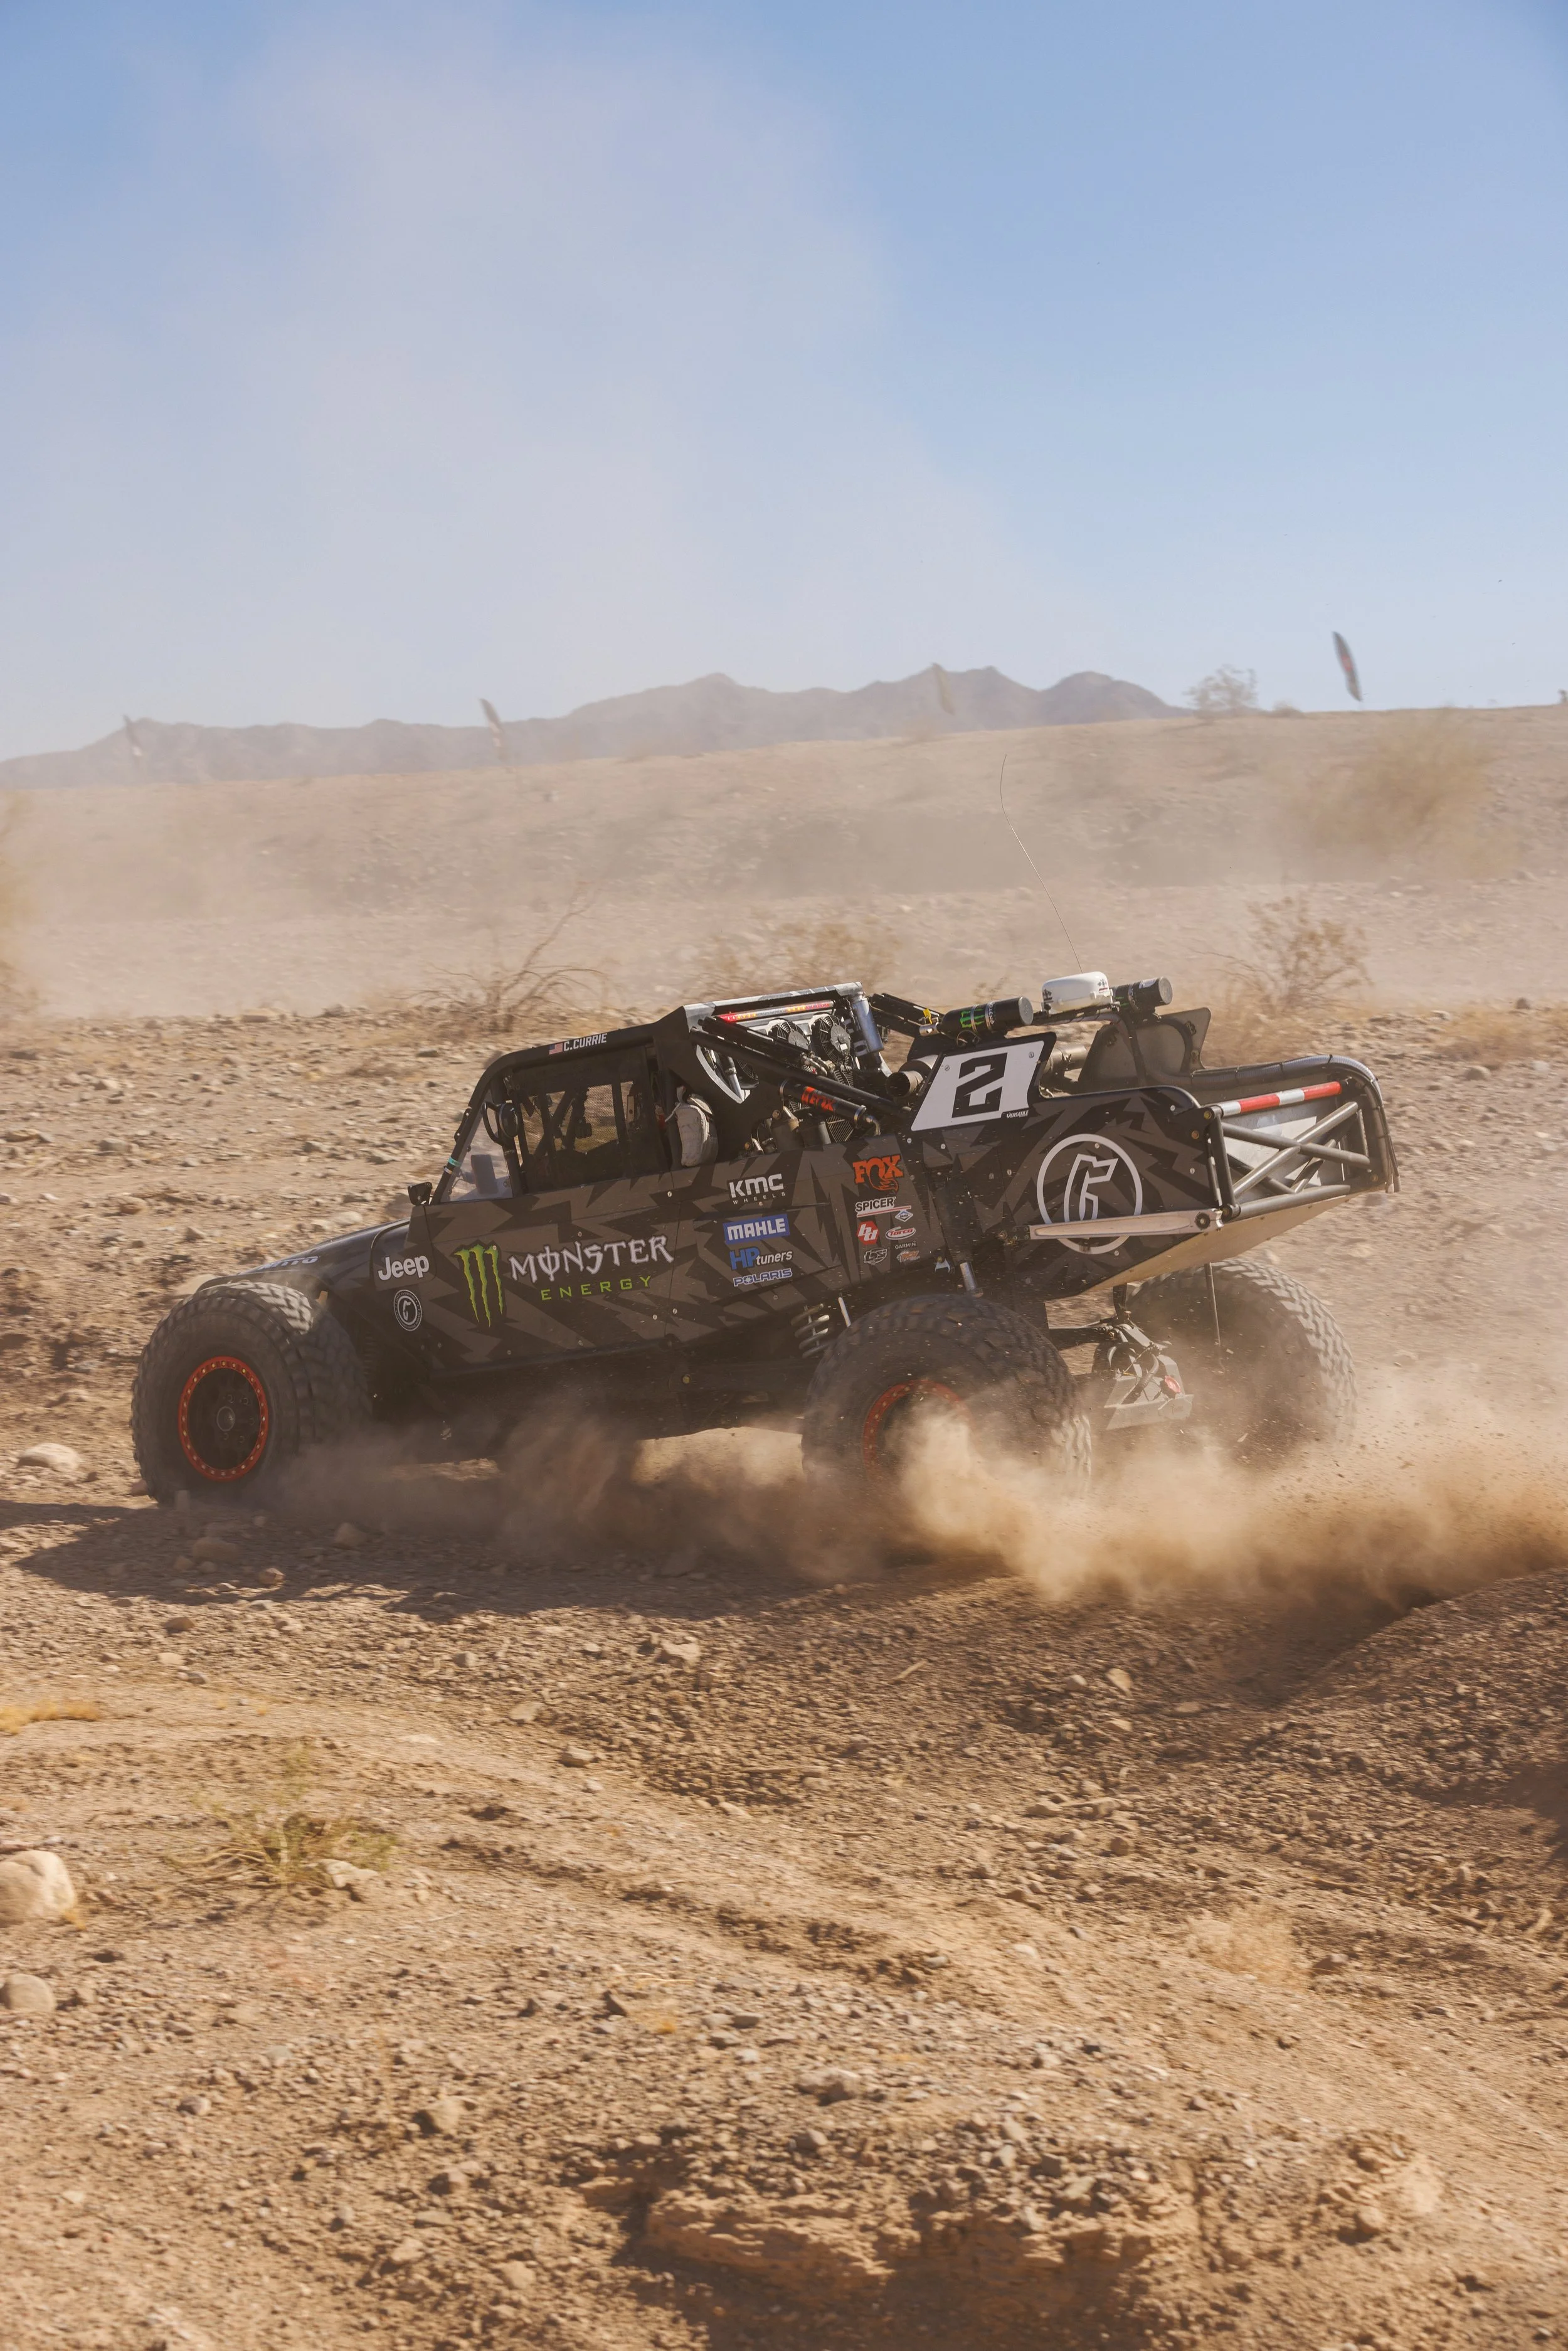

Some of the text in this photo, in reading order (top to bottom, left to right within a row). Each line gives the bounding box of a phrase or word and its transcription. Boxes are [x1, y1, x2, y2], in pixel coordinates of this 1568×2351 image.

[564, 1033, 608, 1051] C.CURRIE
[951, 1053, 1008, 1118] 2
[852, 1154, 904, 1192] FOX
[733, 1191, 785, 1205] WHEELS
[856, 1197, 894, 1212] SPICER
[727, 1218, 787, 1241] MAHLE
[378, 1255, 430, 1282] Jeep
[509, 1234, 675, 1283] MONSTER
[540, 1275, 652, 1301] ENERGY
[733, 1268, 793, 1287] POLARIS
